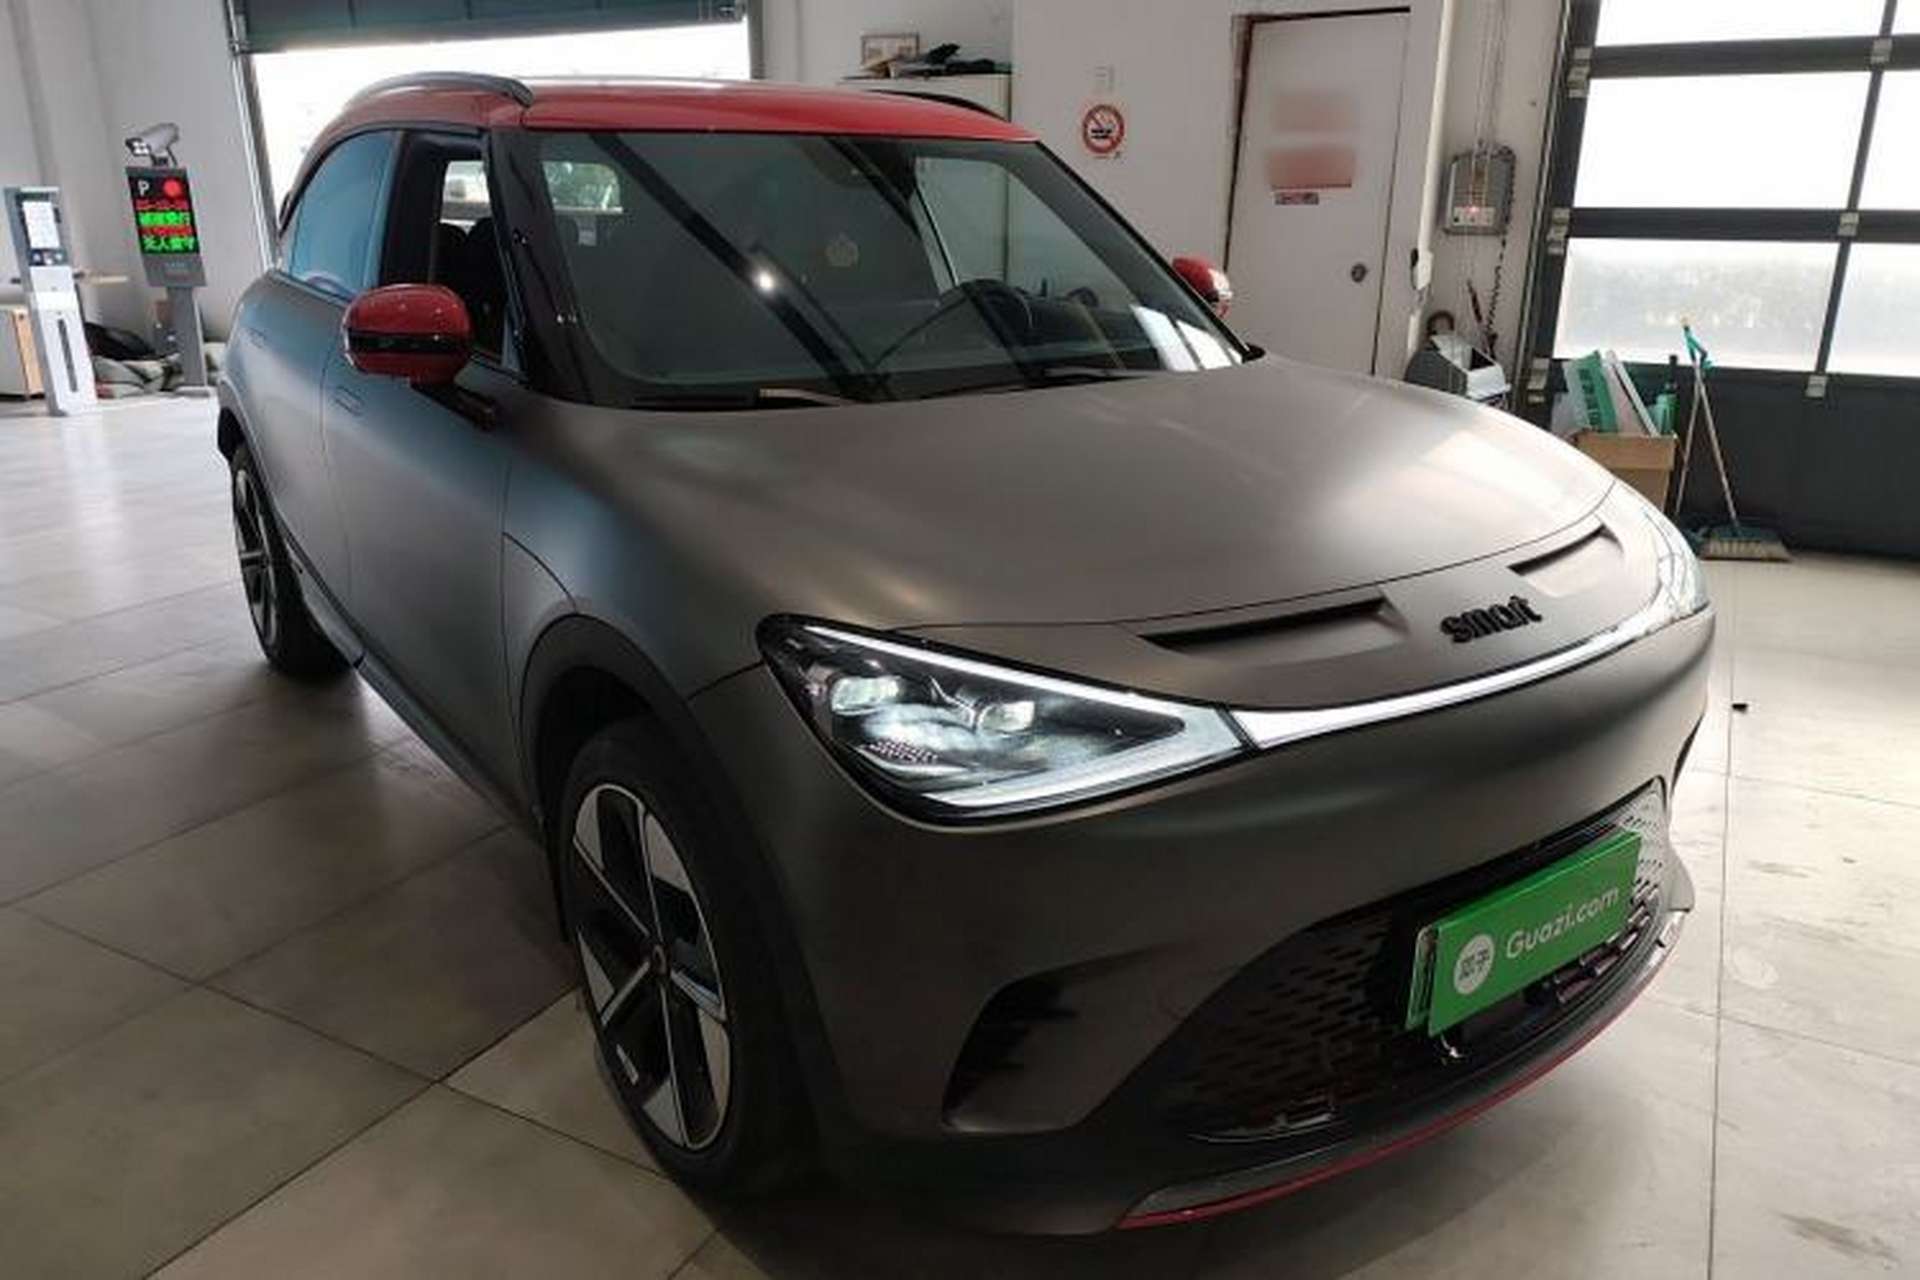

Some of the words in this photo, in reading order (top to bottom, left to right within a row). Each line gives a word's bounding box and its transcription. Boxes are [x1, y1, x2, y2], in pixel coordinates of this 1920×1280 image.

[137, 179, 150, 196] P
[1441, 595, 1542, 643] smart
[1506, 888, 1618, 958] Guazi.com
